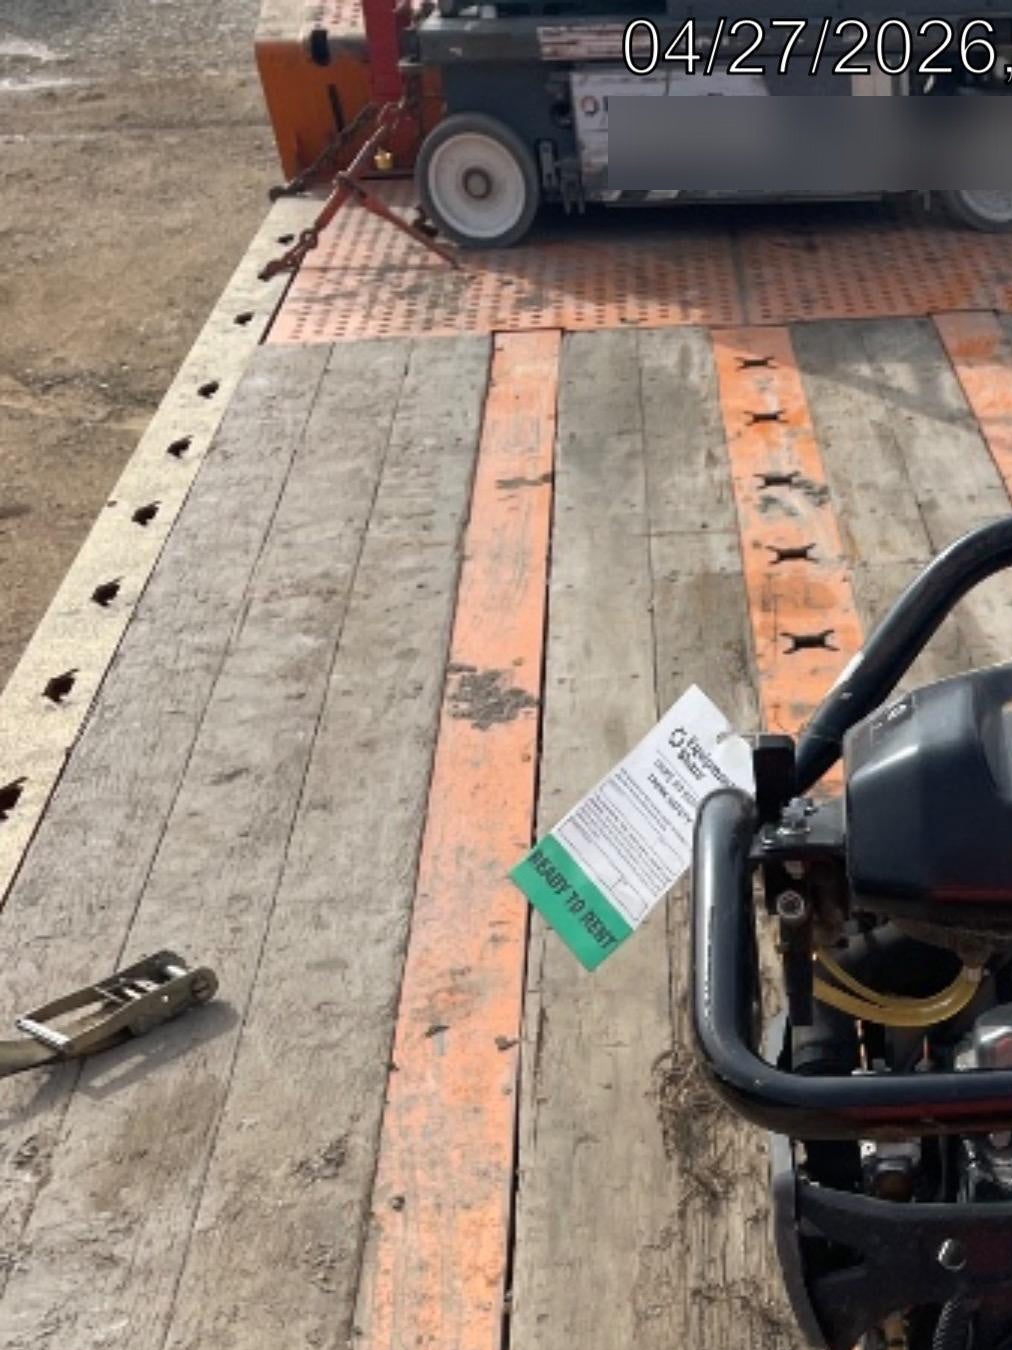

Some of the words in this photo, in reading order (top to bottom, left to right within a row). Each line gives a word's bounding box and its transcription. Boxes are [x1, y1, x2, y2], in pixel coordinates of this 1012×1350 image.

[529, 850, 570, 895] READY
[565, 890, 586, 915] TO
[581, 910, 618, 950] RENT
